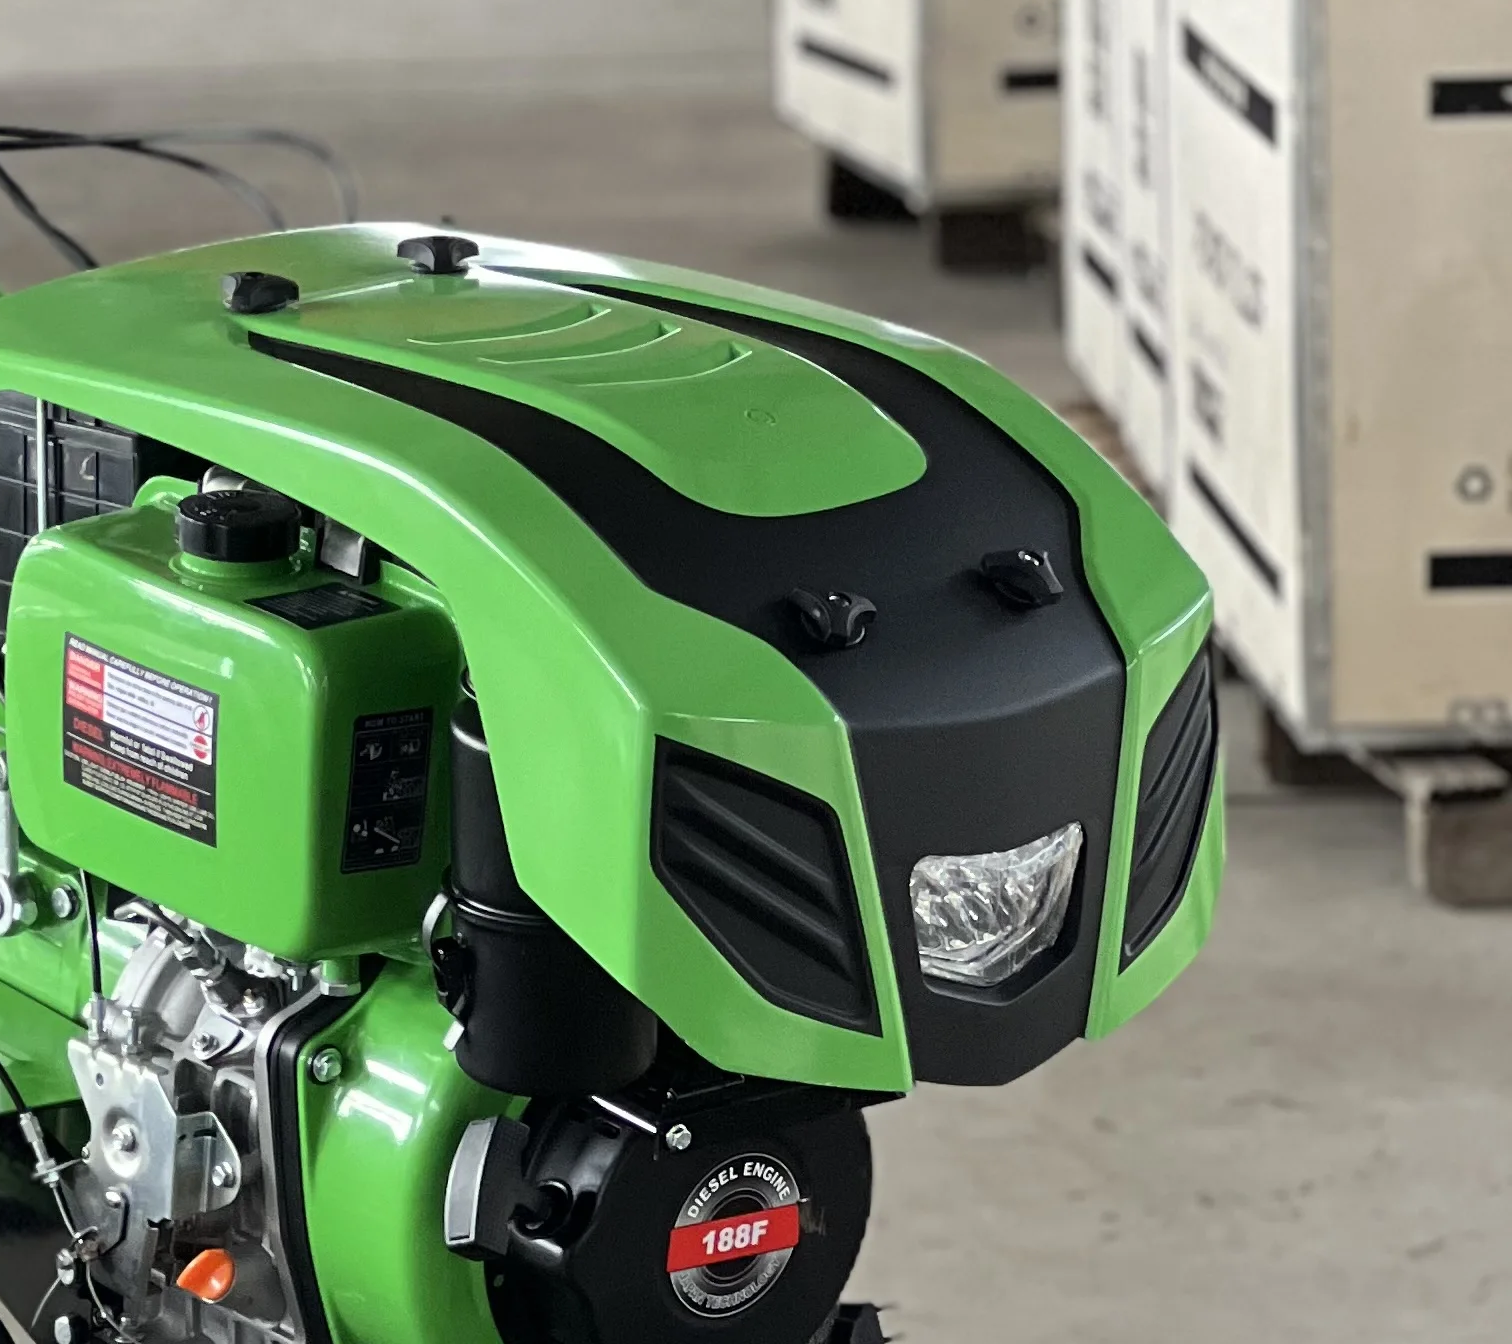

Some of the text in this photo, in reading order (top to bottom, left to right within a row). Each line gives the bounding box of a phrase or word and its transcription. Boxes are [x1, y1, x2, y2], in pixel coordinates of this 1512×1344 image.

[687, 1161, 791, 1218] DIESEL ENGINE
[702, 1219, 769, 1255] 188F
[705, 1259, 781, 1310] TECHNOLOGY
